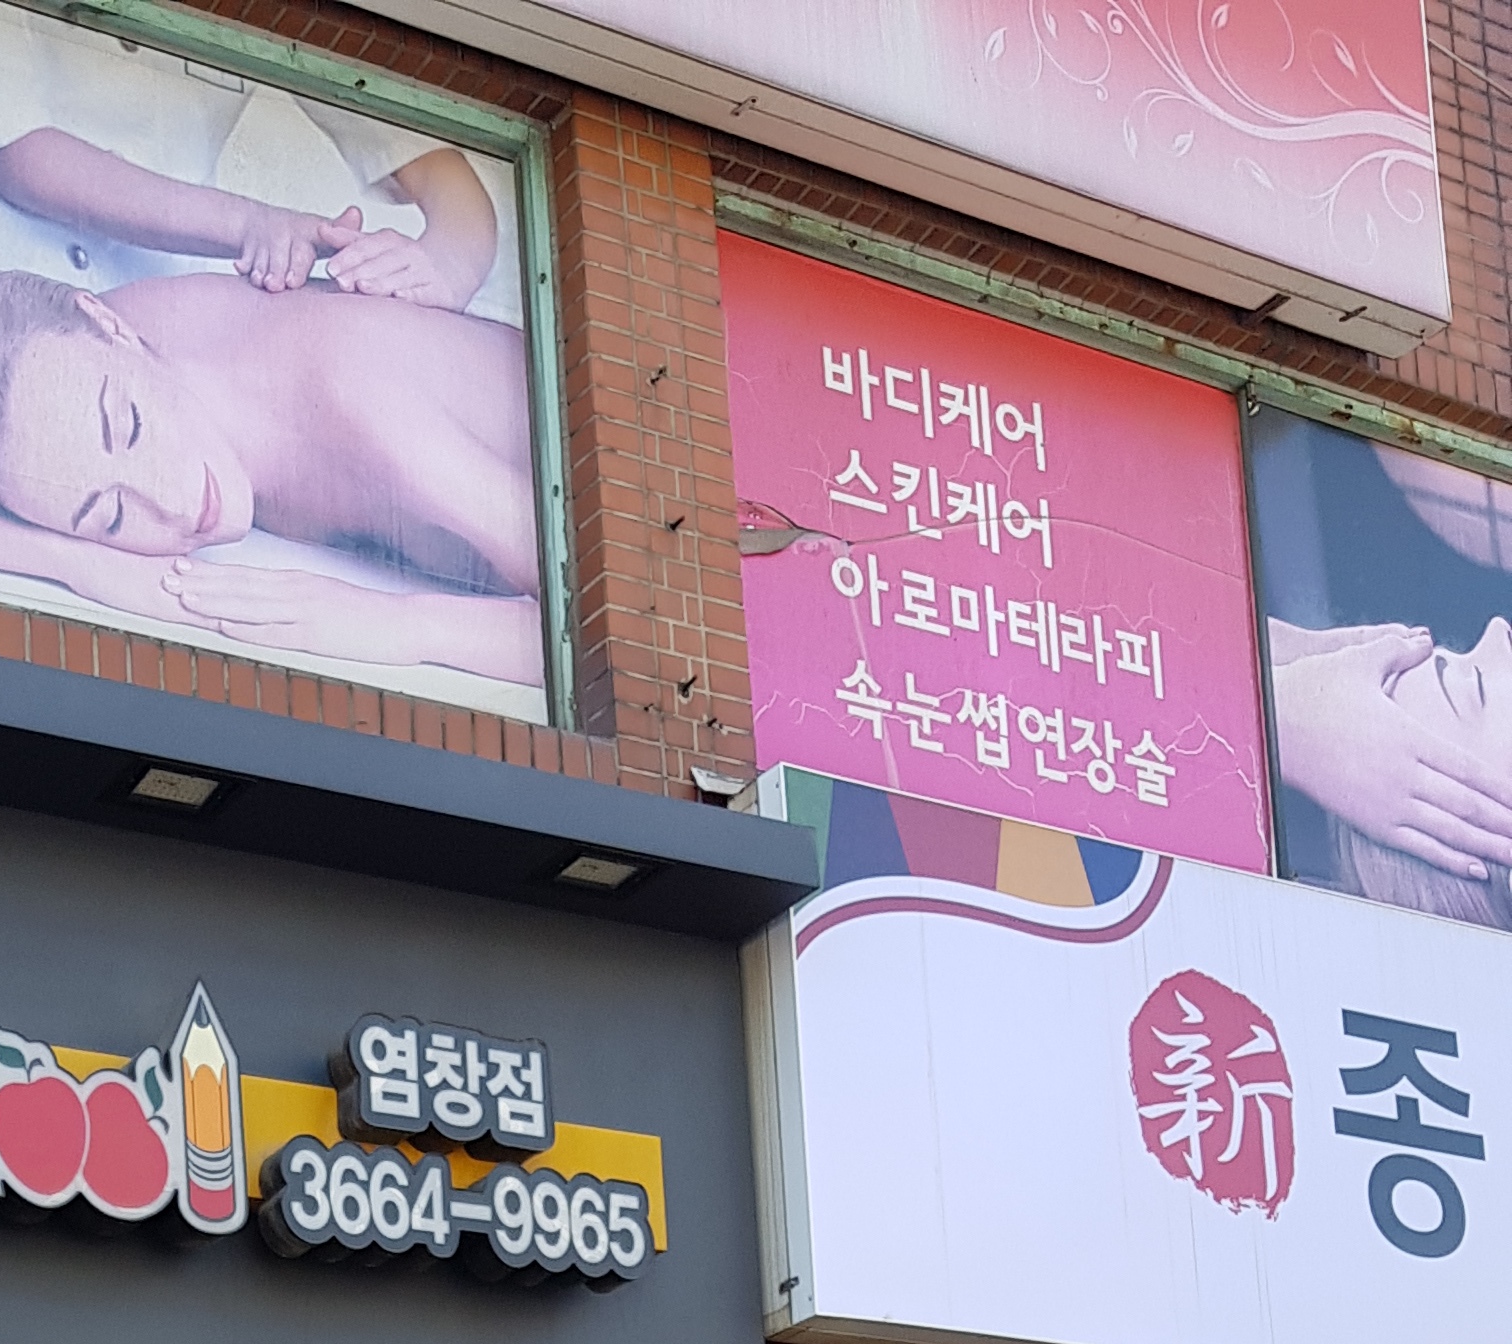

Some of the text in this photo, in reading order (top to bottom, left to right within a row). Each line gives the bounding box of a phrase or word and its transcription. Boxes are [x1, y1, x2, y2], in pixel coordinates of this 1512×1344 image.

[821, 346, 1047, 471] 바디케어
[829, 448, 1054, 568] 스킨케어
[830, 553, 1167, 700] 아로마테라피
[834, 658, 1178, 808] 속눈썹연장술
[357, 1023, 546, 1140] 염창점
[1332, 1007, 1486, 1260] 종
[288, 1146, 647, 1270] 3664-9965
